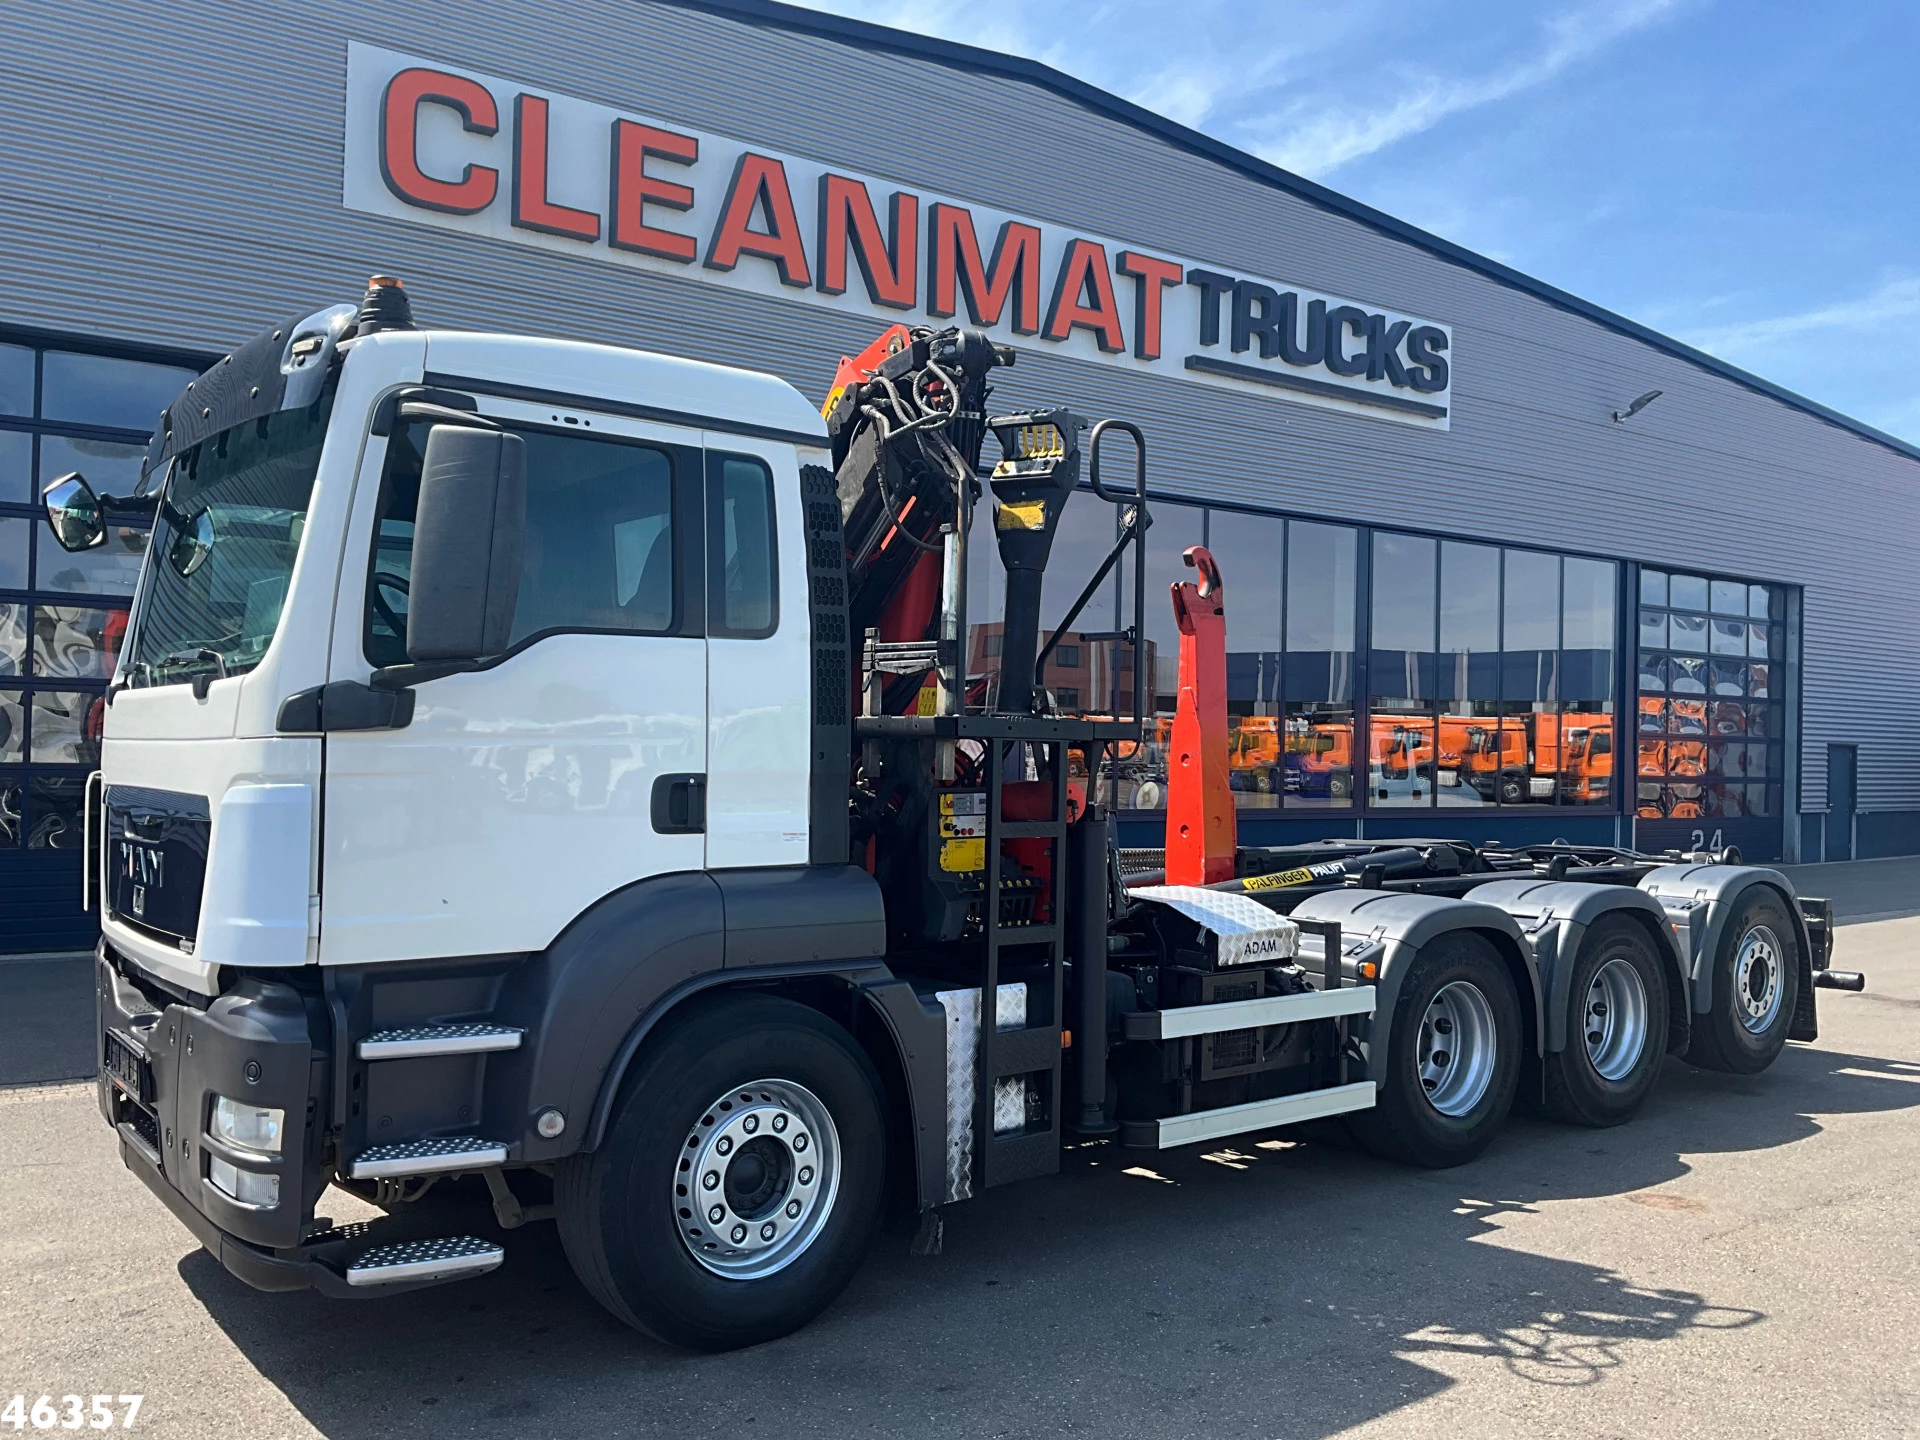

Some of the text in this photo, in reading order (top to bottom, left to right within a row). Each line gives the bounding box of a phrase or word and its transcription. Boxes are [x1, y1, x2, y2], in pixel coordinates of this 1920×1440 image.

[378, 66, 1449, 394] CLEANMAT TRUCKS
[1691, 829, 1723, 854] 24
[120, 842, 164, 888] MAN
[1247, 862, 1347, 890] PALFINGER PALIFT
[1244, 939, 1277, 956] ADAM
